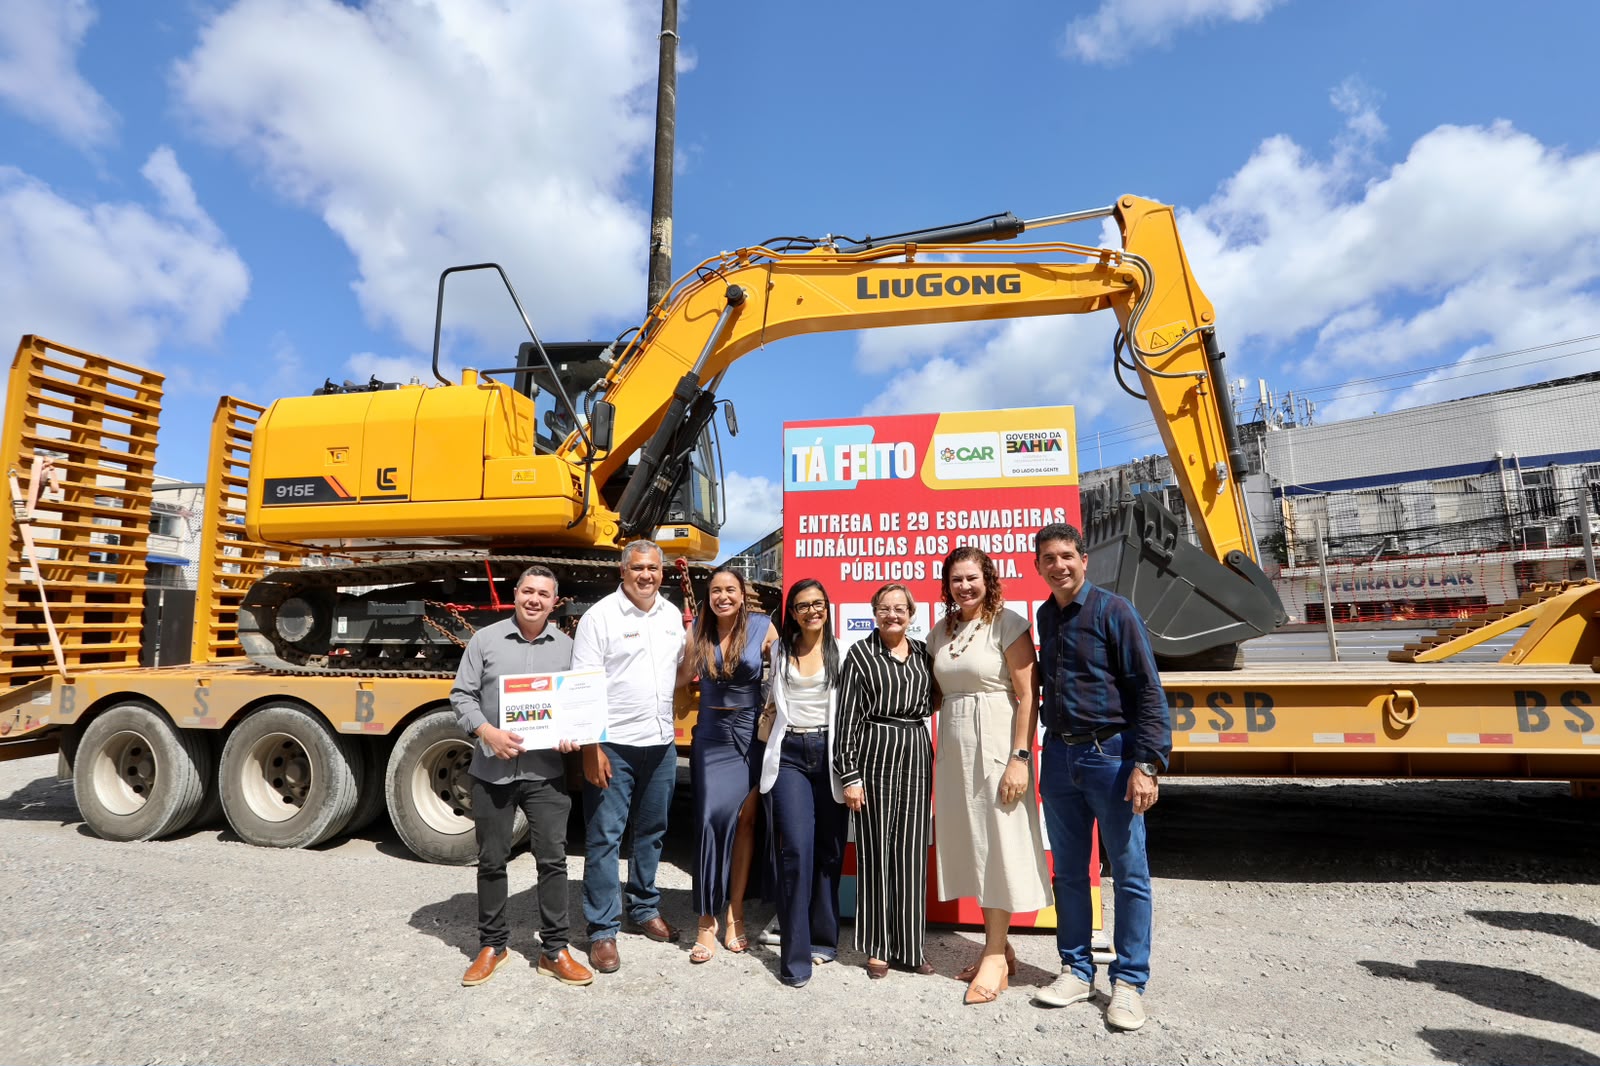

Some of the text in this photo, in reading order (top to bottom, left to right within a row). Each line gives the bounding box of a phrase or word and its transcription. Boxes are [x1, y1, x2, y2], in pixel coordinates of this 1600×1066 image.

[1006, 433, 1048, 441] GOVERNO
[1006, 439, 1062, 453] BAHIA
[791, 437, 916, 482] TÁ FEITO
[956, 446, 994, 461] CAR
[276, 484, 315, 498] 915E
[799, 507, 1066, 534] ENTREGA DE 29 ESCAVADEIRAS
[795, 530, 1037, 558] HIDRÁULICAS AOS CONSÓRC
[840, 558, 926, 581] PÚBLICOS
[932, 560, 943, 580] D
[855, 620, 871, 628] CTR
[505, 709, 552, 723] BAHIA
